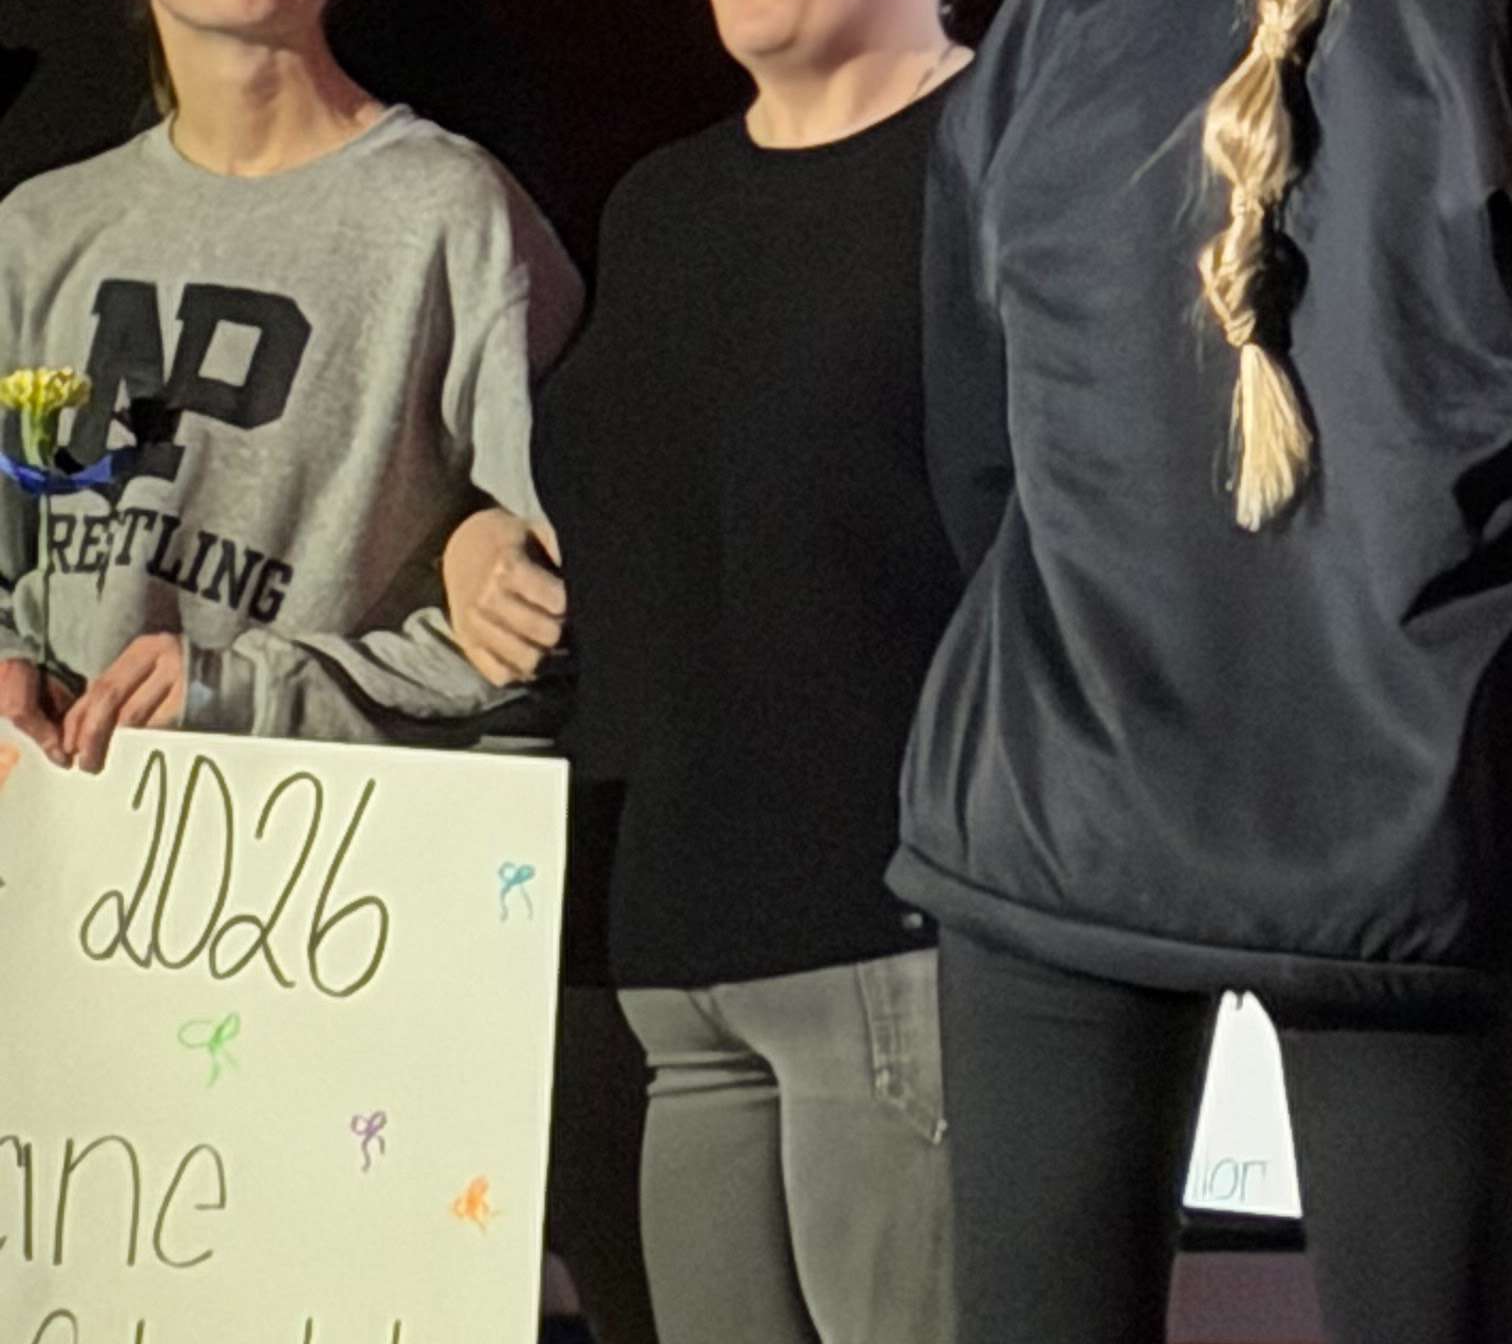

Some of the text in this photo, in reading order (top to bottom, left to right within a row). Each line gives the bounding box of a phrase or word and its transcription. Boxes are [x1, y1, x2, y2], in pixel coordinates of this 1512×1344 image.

[66, 278, 312, 481] NP
[48, 506, 292, 623] RETLING
[79, 749, 390, 999] 2026
